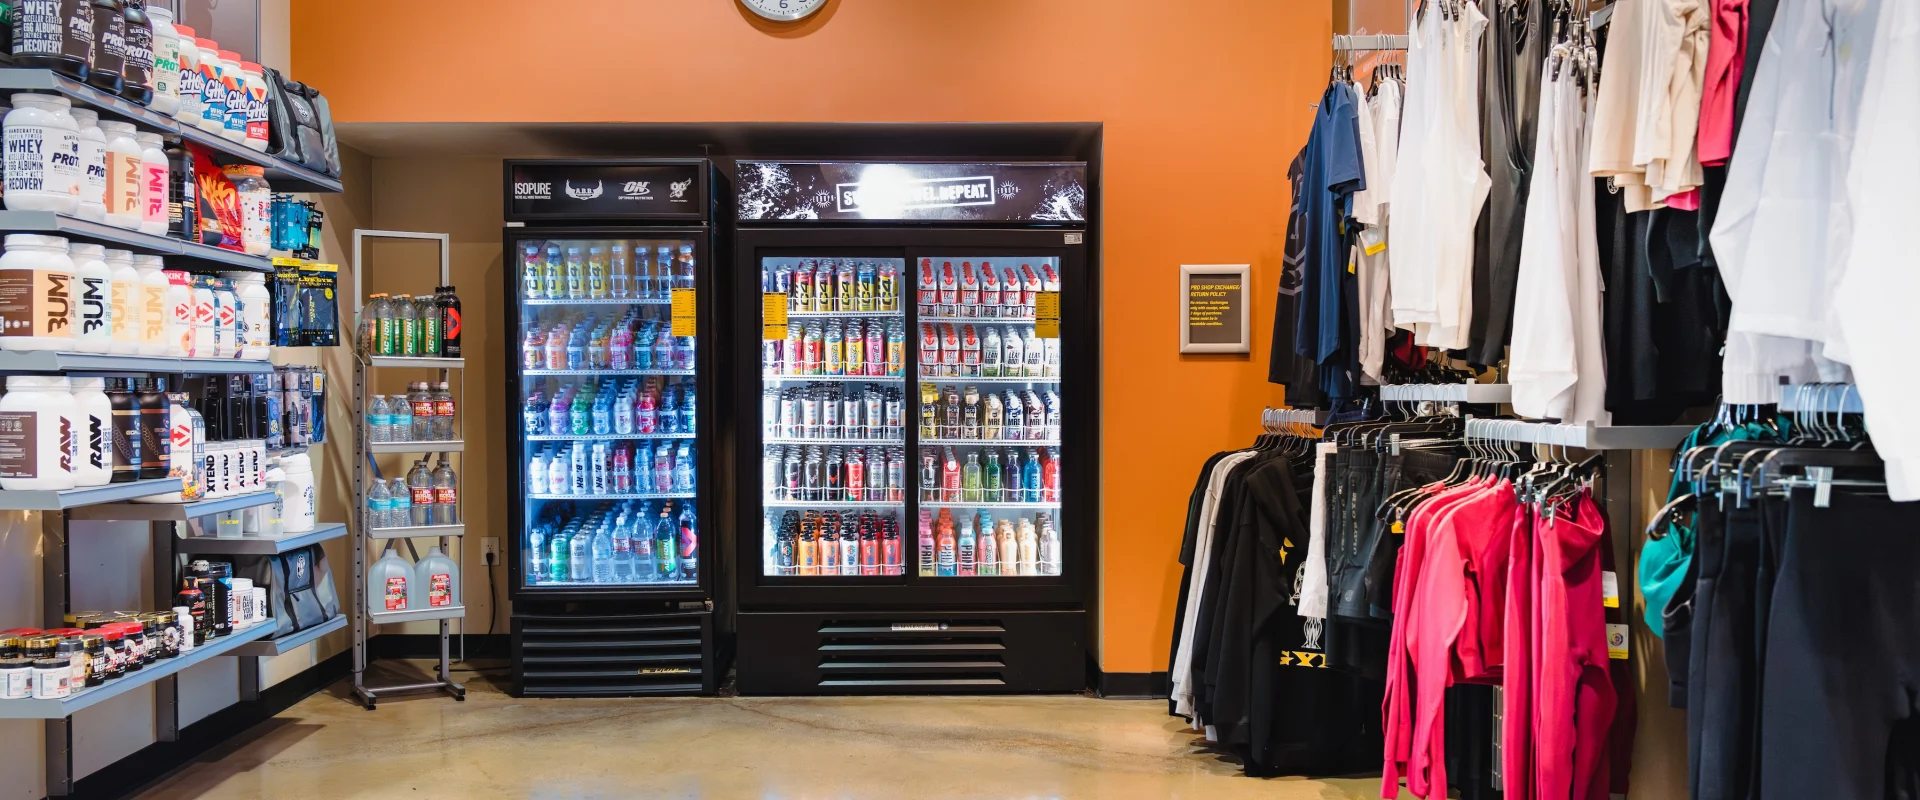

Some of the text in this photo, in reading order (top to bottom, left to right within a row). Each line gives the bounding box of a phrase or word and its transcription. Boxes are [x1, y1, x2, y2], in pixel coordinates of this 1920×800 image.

[24, 1, 62, 16] WHEY
[24, 22, 62, 33] EGG ALBUMIN
[24, 39, 62, 54] RECOVERY
[250, 126, 267, 134] WHEY
[9, 139, 43, 153] WHEY
[9, 160, 43, 171] EGG ALBUMIN
[9, 177, 43, 191] RECOVERY
[515, 183, 551, 194] ISOPURE
[624, 182, 650, 193] ON
[528, 266, 538, 289] C4
[549, 265, 558, 289] C4
[570, 265, 579, 289] C4
[592, 264, 602, 289] C4
[801, 281, 808, 305] C4
[820, 281, 828, 305] C4
[842, 281, 850, 305] C4
[862, 280, 870, 305] C4
[882, 279, 892, 305] C4
[60, 415, 72, 473] RAW
[89, 413, 102, 470] RAW
[206, 454, 216, 493] XTEND
[921, 545, 932, 572] PRIME
[941, 543, 952, 574] PRIME
[962, 545, 973, 572] PRIME
